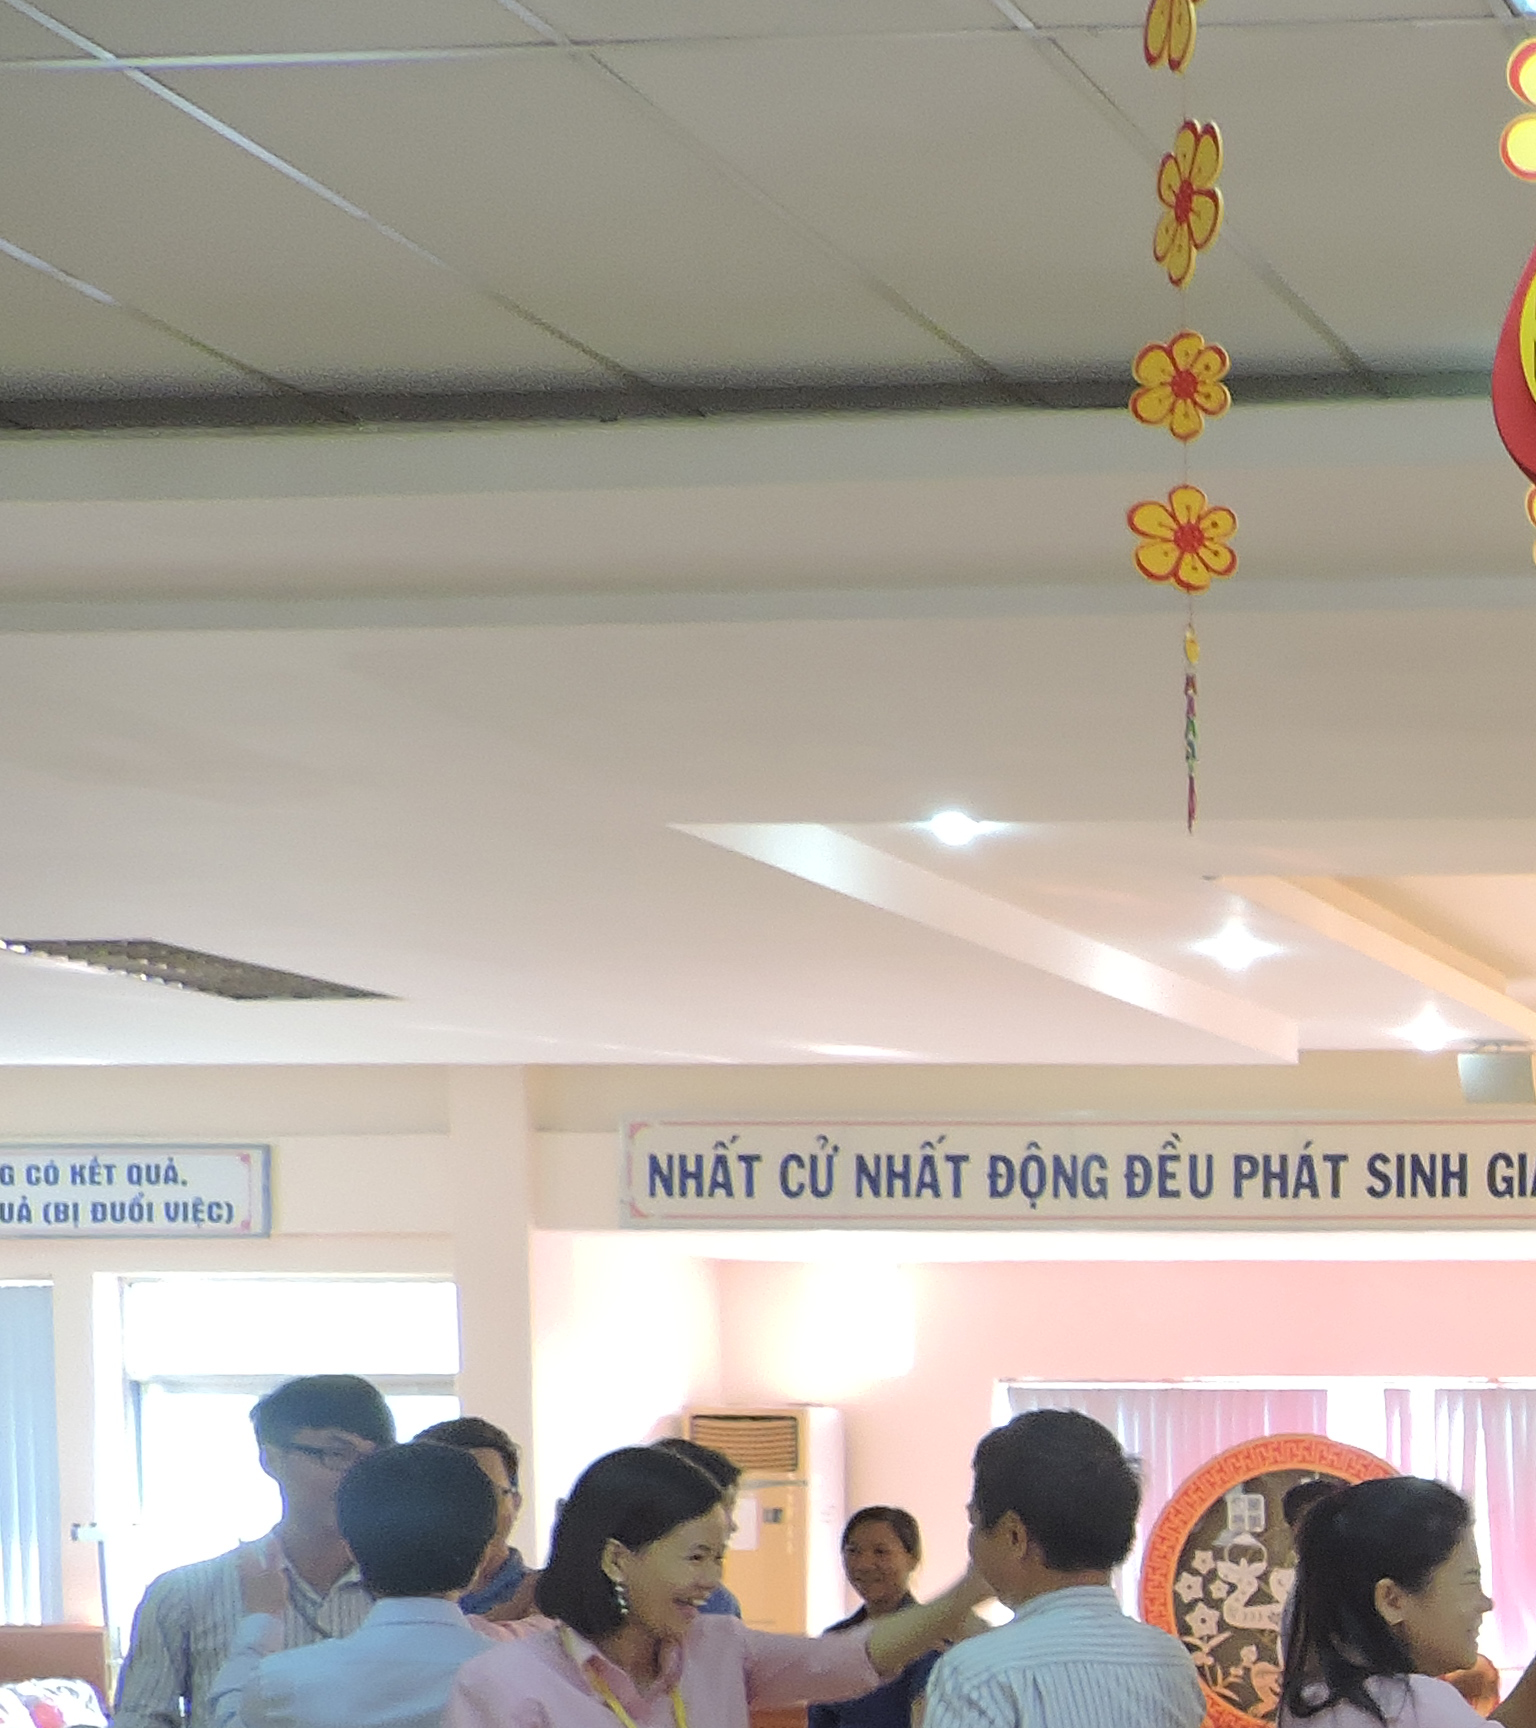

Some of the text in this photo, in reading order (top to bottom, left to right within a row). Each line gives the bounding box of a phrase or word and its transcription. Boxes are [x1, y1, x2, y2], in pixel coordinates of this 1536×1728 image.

[26, 1160, 60, 1186] CÓ
[70, 1155, 117, 1186] KẾT
[648, 1135, 762, 1199] NHẤT
[779, 1135, 840, 1199] CỬ
[855, 1135, 970, 1199] NHẤT
[986, 1141, 1108, 1210] ĐỘNG
[1123, 1132, 1214, 1199] ĐỀU
[1233, 1140, 1349, 1199] PHÁT
[1366, 1152, 1468, 1199] SINH
[90, 1191, 154, 1224] ĐUỔI
